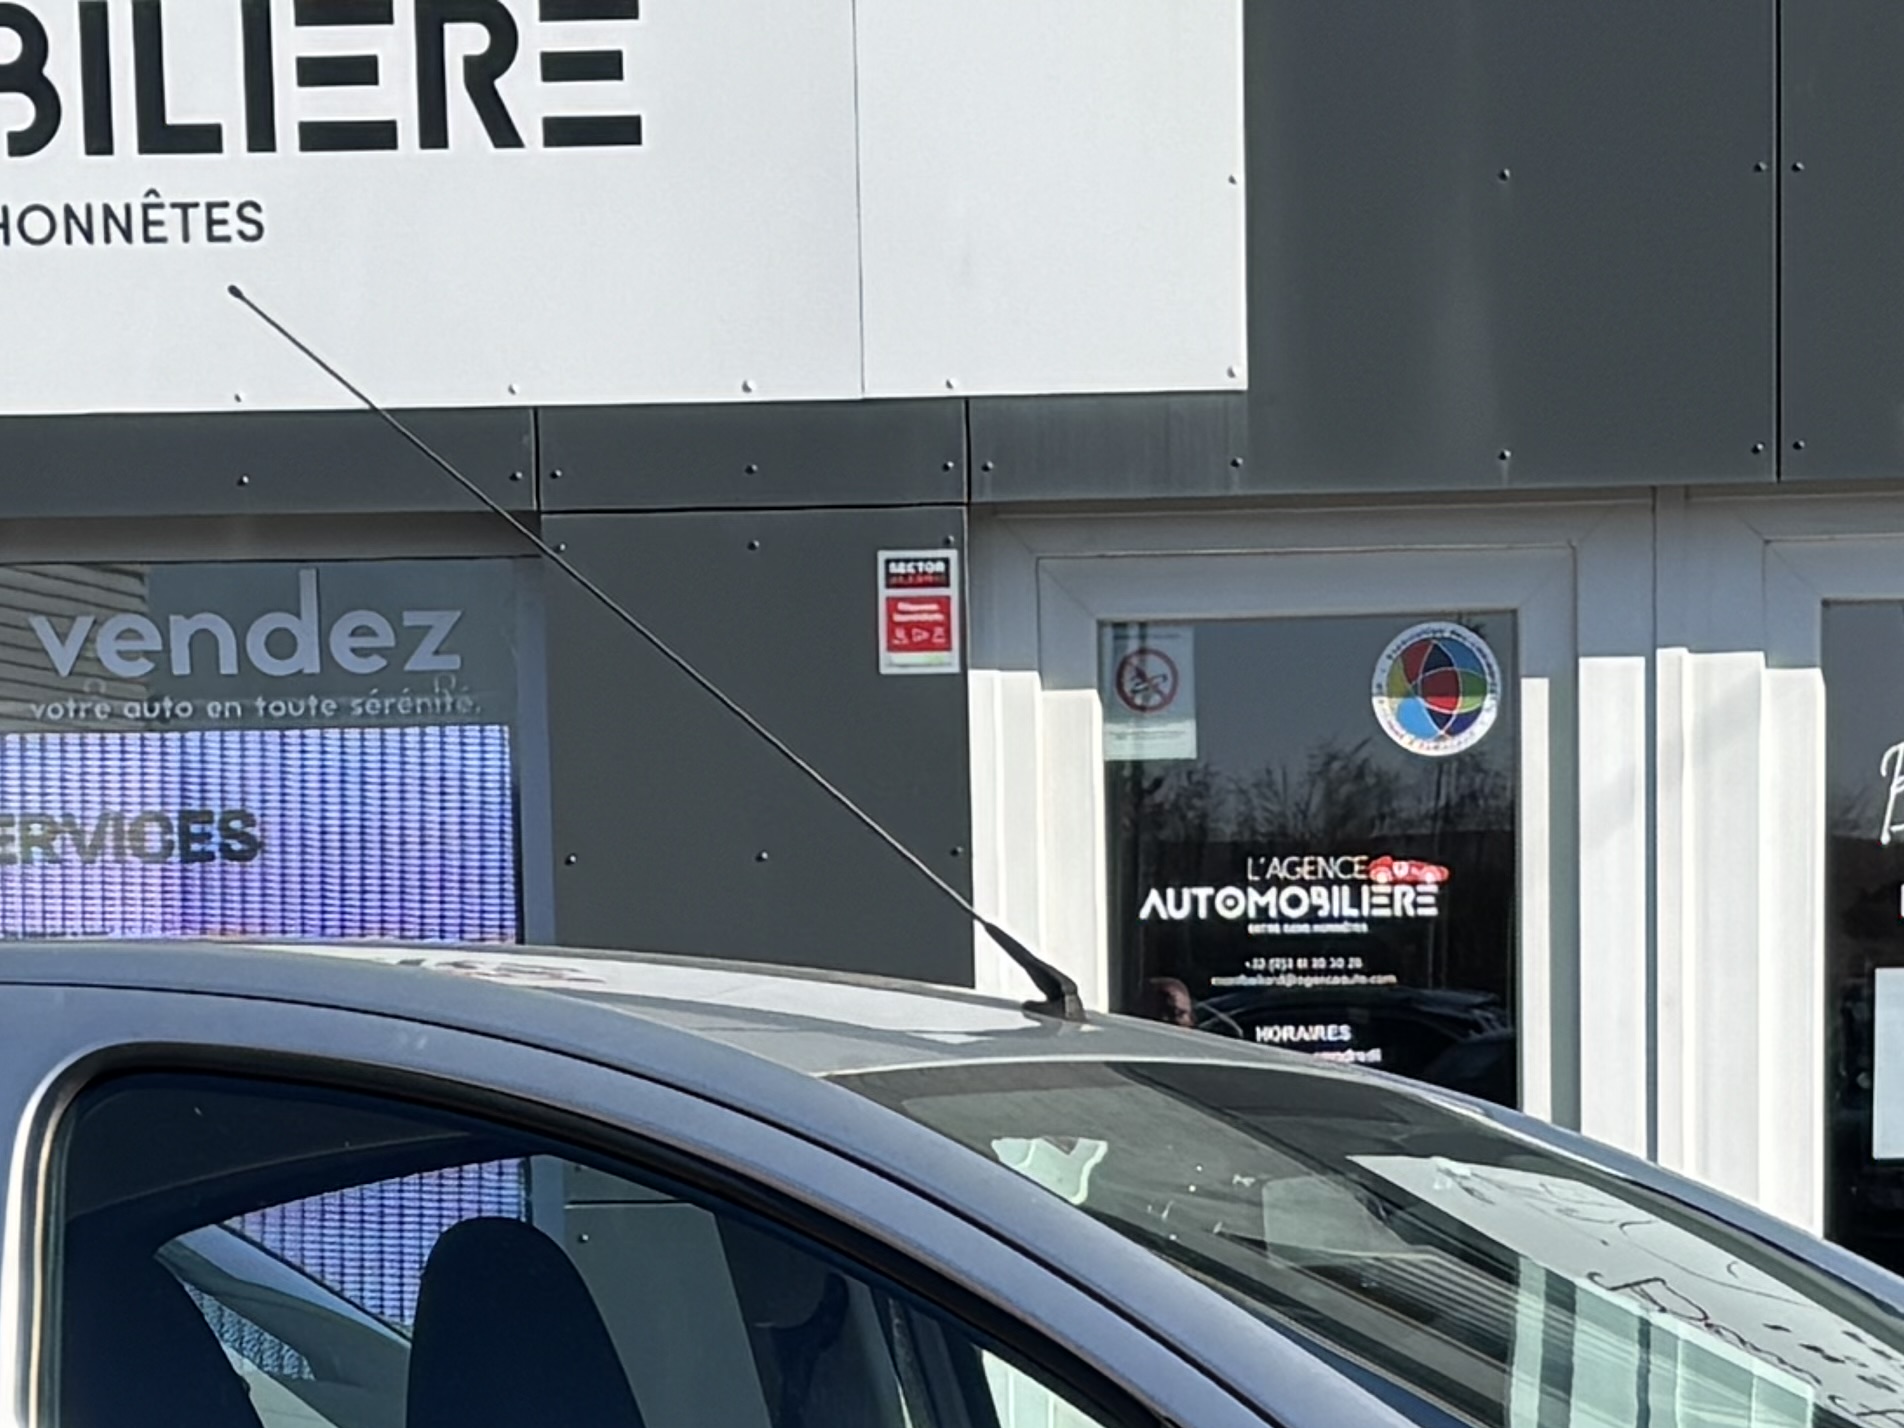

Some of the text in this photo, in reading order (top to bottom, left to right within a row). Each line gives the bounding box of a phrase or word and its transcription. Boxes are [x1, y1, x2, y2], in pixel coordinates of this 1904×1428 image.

[29, 568, 464, 680] vendez
[29, 697, 113, 721] votre
[123, 696, 194, 720] auto
[205, 698, 243, 719] en
[253, 694, 338, 718] toute
[1247, 856, 1368, 881] L'AGENCE
[1138, 883, 1439, 920] AUTOMOBILIERE
